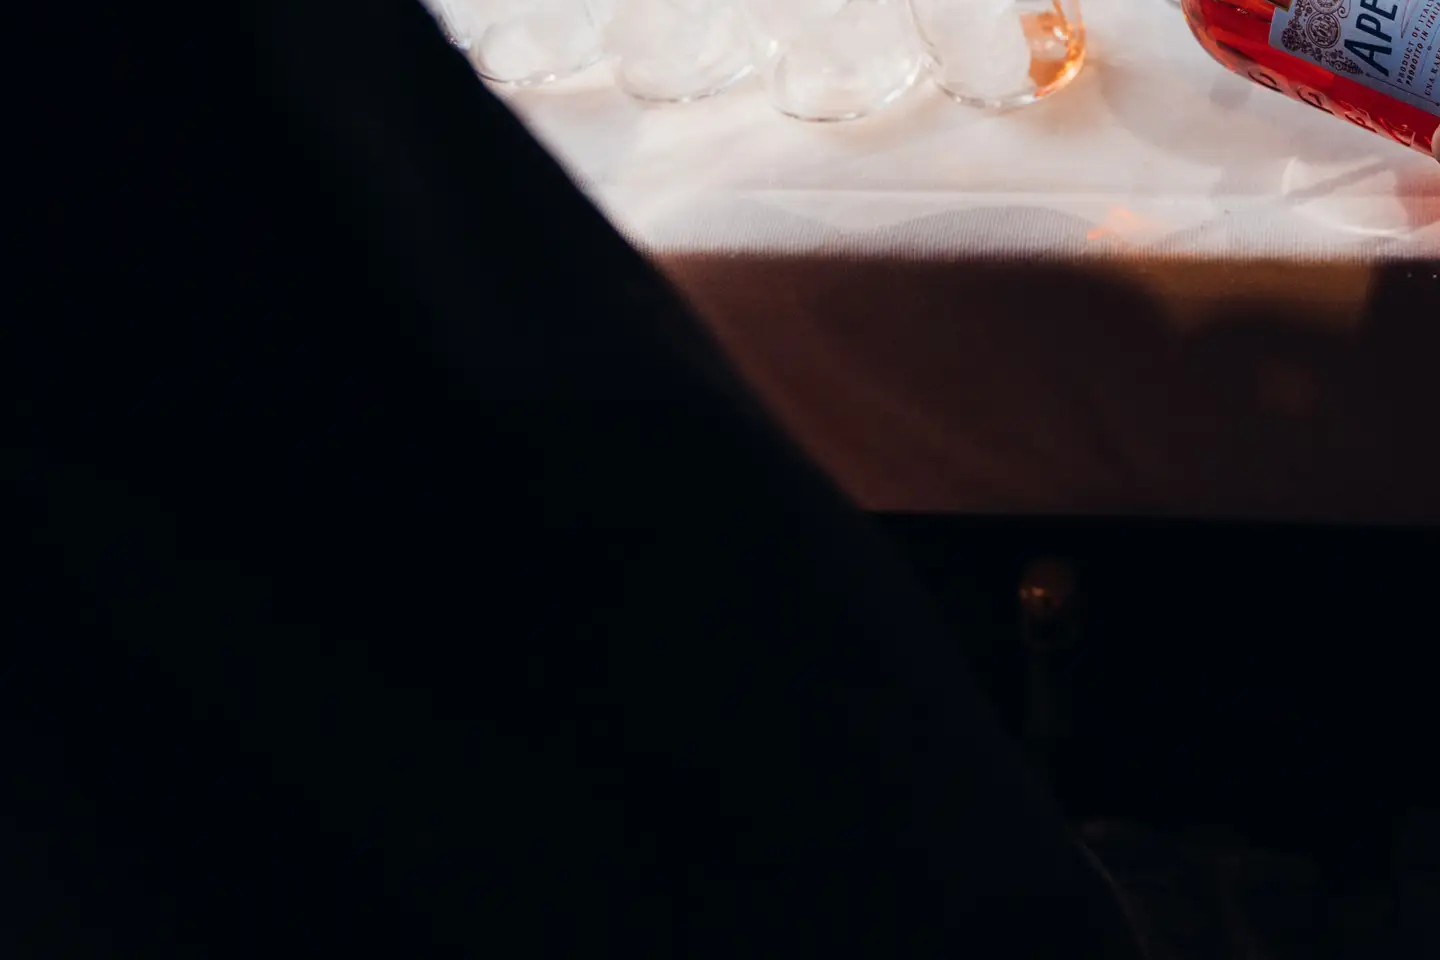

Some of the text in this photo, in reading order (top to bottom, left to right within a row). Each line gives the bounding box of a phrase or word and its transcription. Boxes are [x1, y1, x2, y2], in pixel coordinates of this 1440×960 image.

[1397, 41, 1414, 84] PRODUCT
[1411, 26, 1420, 38] OF
[1405, 43, 1424, 86] PRODOTTO
[1420, 31, 1429, 41] IN
